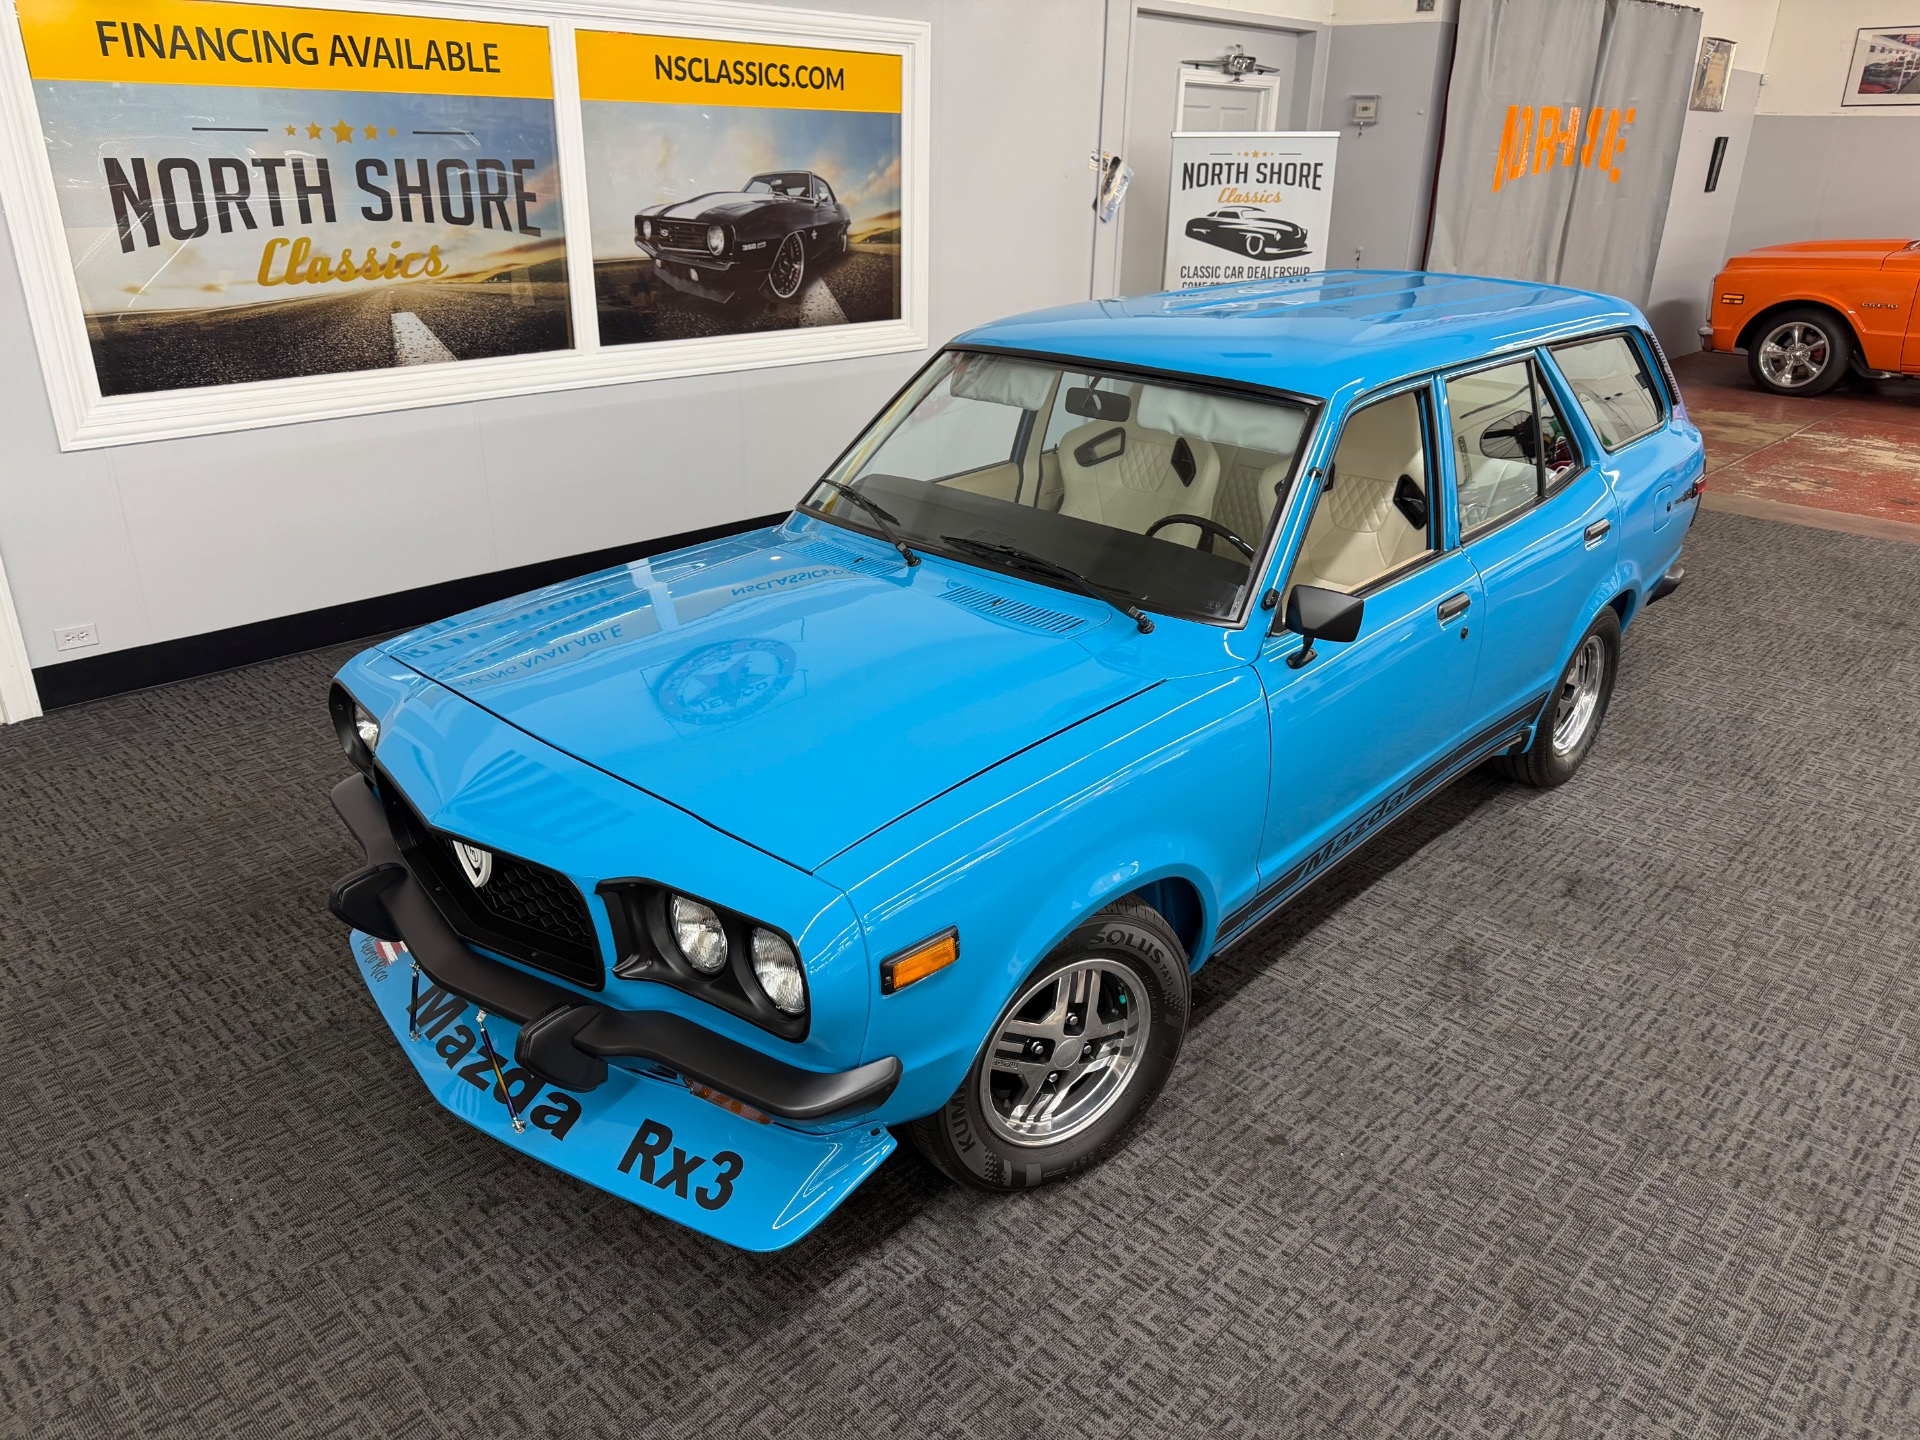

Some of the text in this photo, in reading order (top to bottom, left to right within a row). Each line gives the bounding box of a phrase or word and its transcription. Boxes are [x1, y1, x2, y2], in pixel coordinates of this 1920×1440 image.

[95, 20, 501, 74] FINANCING AVAILABLE
[654, 54, 845, 91] NSCLASSICS.COM
[1181, 162, 1324, 191] NORTH SHORE
[102, 157, 542, 254] NORTH SHORE
[1217, 187, 1283, 204] Classics
[257, 237, 449, 287] Classics
[1180, 265, 1311, 279] CLASSIC CAR DEALERSHIP
[1303, 792, 1405, 877] Mazda
[1090, 929, 1165, 965] SOLUS
[370, 957, 389, 983] Rico
[405, 985, 744, 1211] Mazda Rx3
